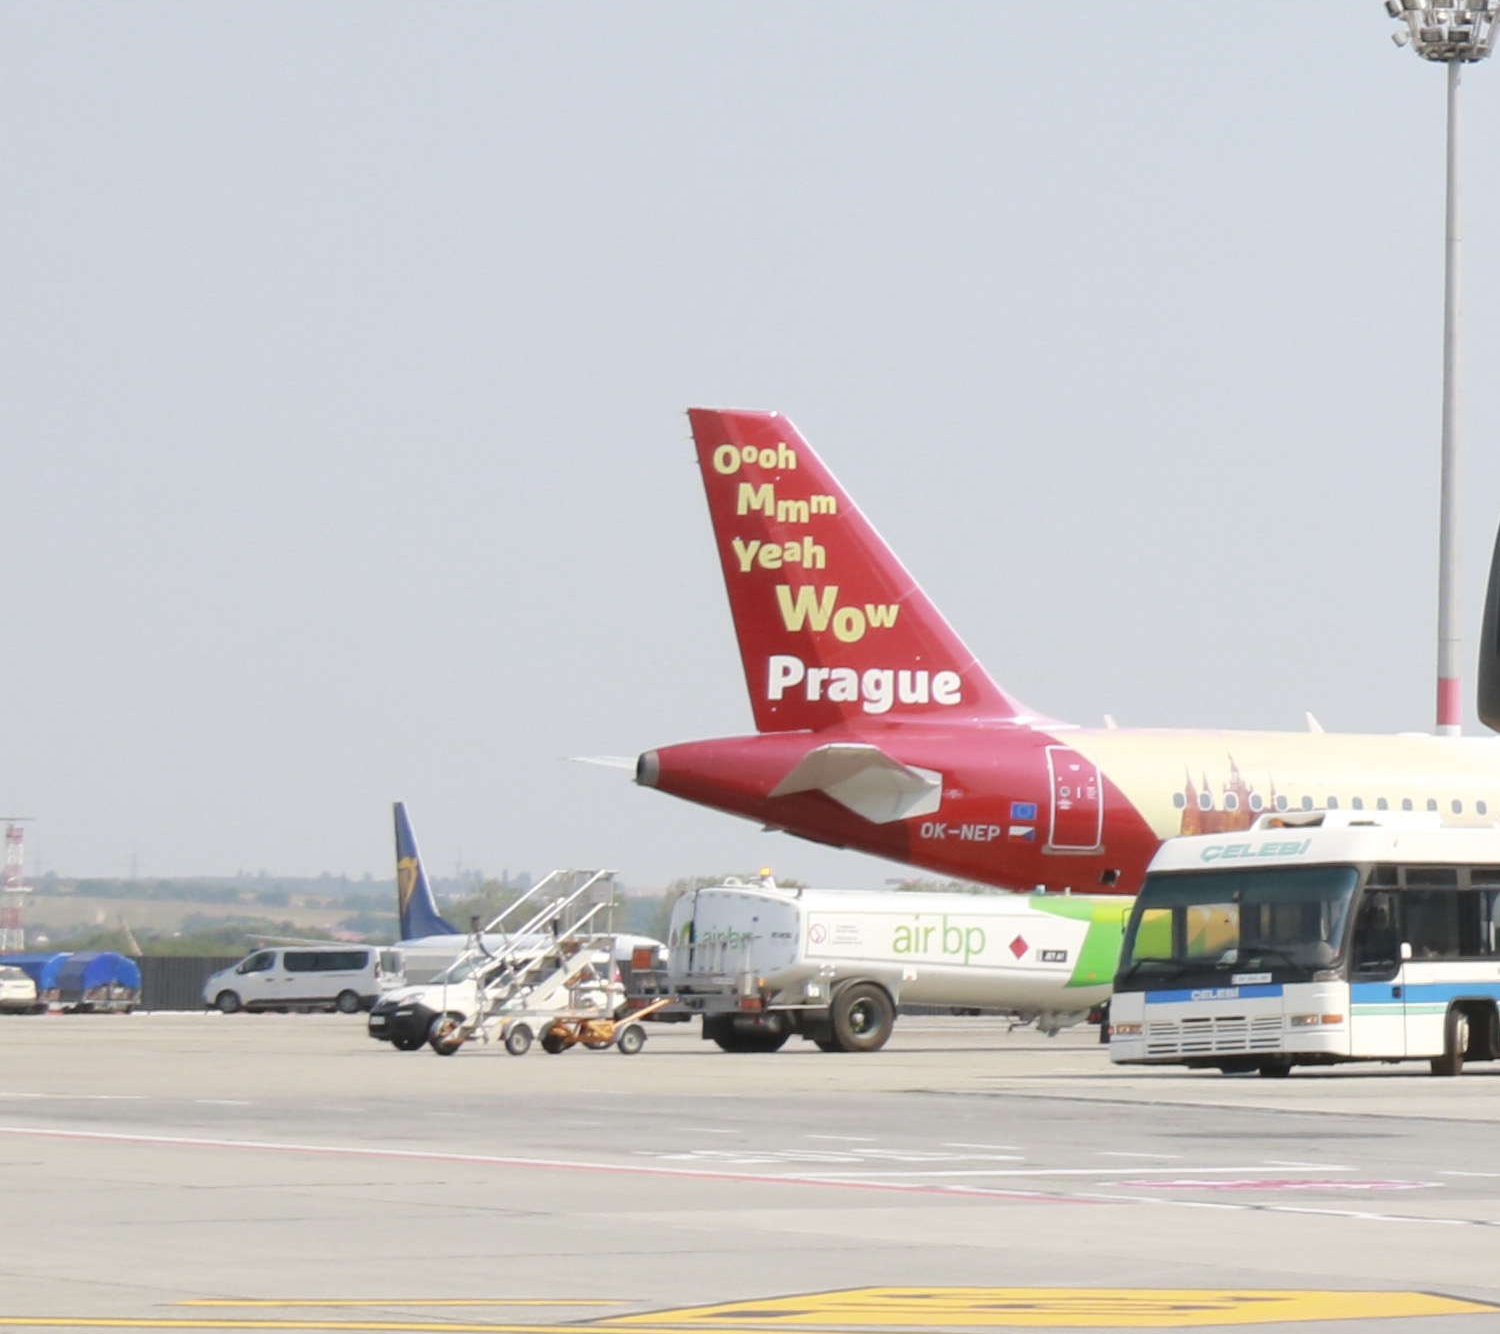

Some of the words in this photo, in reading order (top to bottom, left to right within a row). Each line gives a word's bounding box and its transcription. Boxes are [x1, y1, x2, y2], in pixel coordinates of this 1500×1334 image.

[713, 443, 797, 474] Oooh
[737, 483, 837, 523] Mmm
[732, 536, 826, 572] Yeah
[775, 585, 899, 643] Wow
[767, 655, 962, 714] Prague
[921, 822, 1000, 842] OK-NEP
